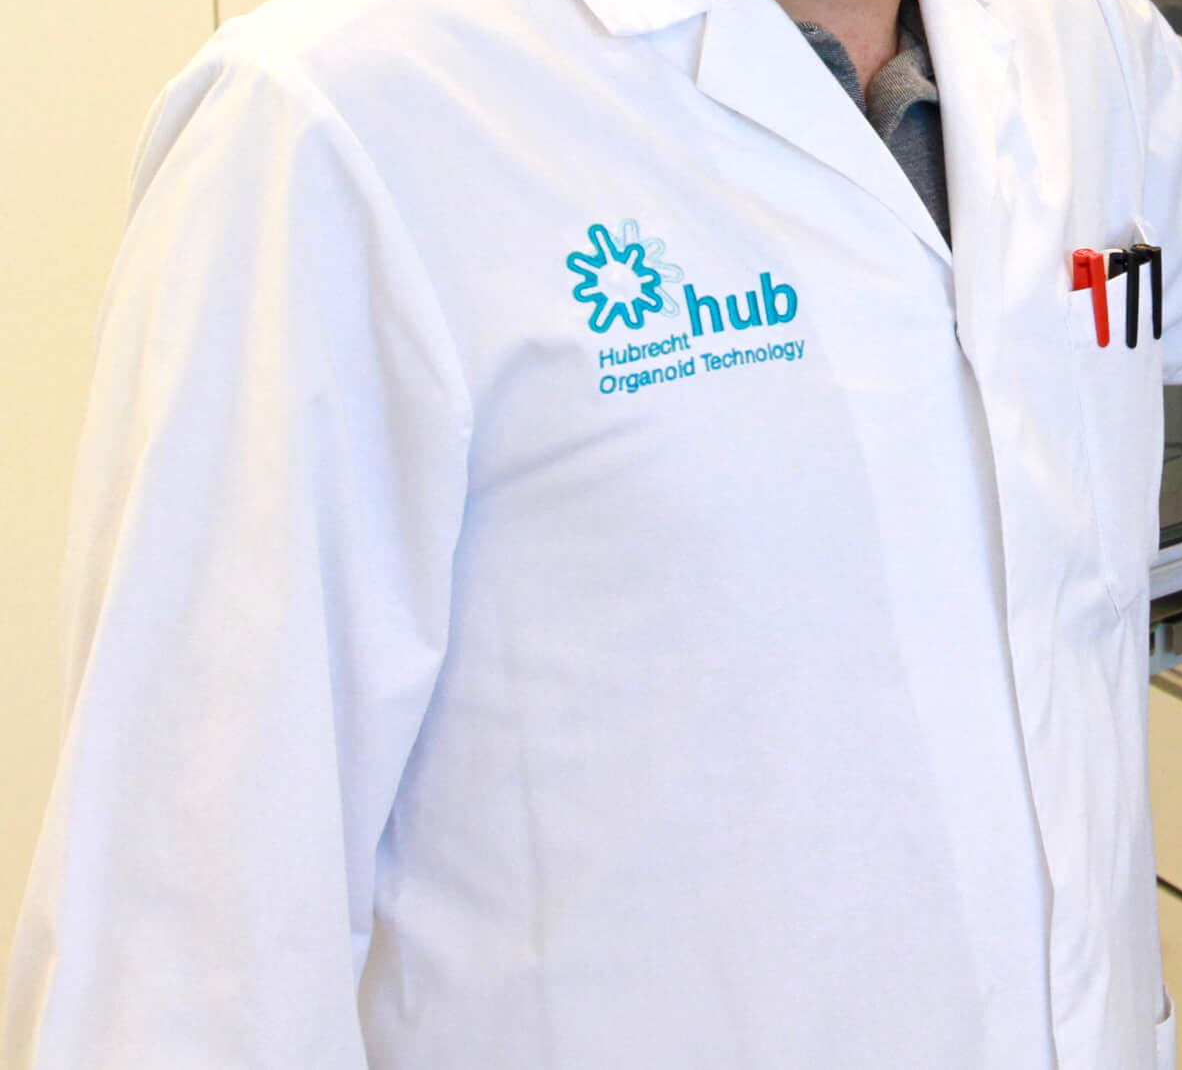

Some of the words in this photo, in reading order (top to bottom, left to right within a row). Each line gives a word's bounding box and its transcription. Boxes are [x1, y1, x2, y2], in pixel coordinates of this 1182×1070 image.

[683, 272, 798, 337] hub
[599, 333, 691, 369] Hubrecht
[599, 357, 696, 394] Organoid
[700, 339, 805, 372] Technology
